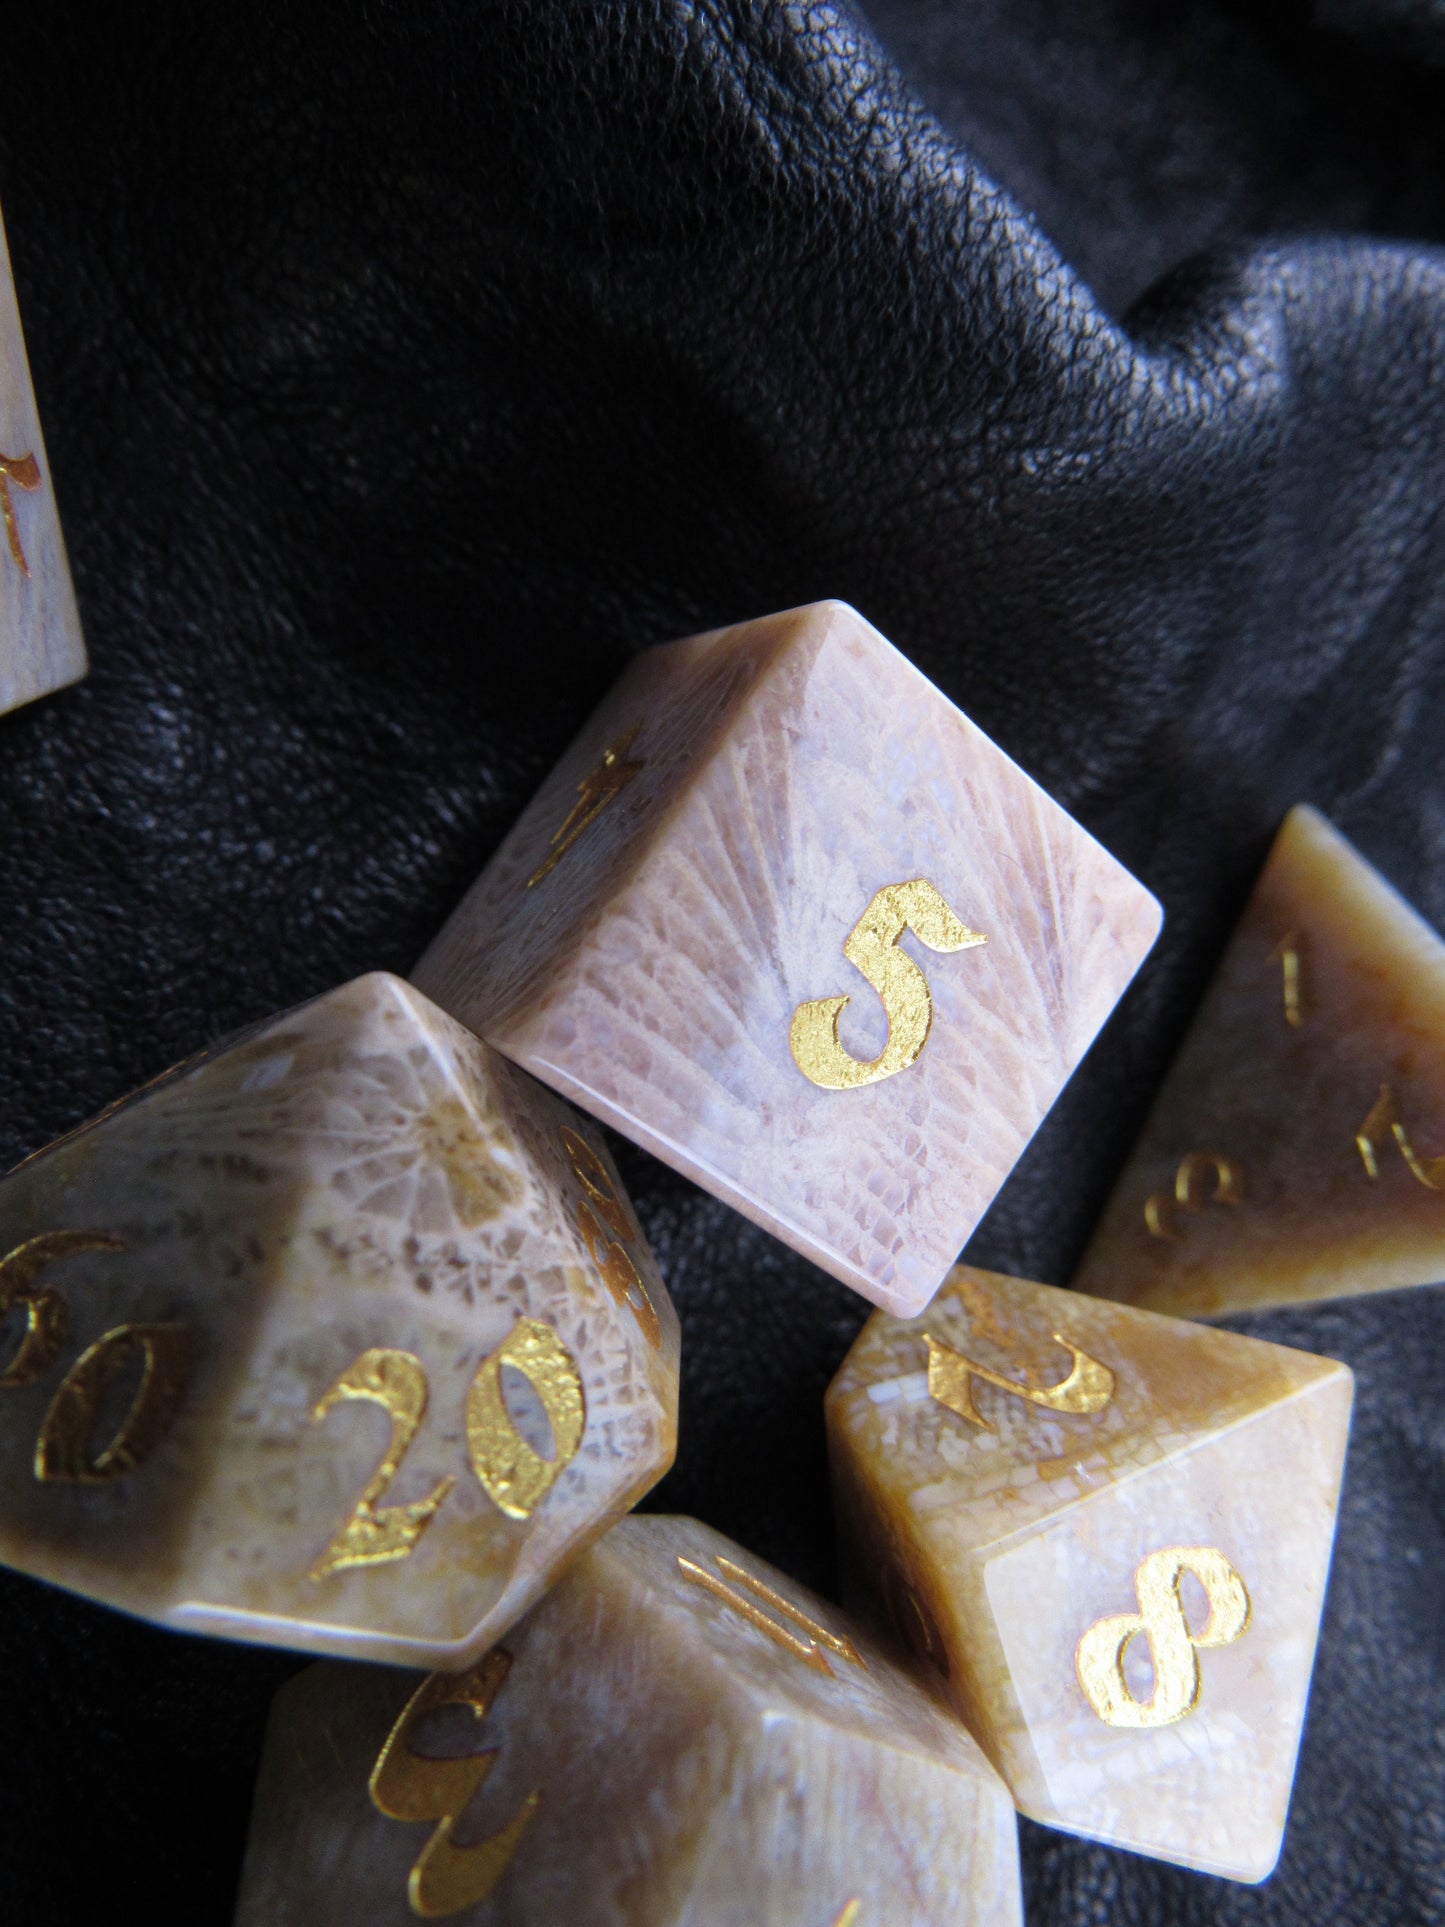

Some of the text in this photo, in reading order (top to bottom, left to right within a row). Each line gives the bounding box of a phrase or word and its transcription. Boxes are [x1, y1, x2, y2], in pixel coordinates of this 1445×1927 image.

[789, 876, 989, 1091] 5
[309, 1316, 587, 1583] 20
[1074, 1544, 1252, 1729] 8
